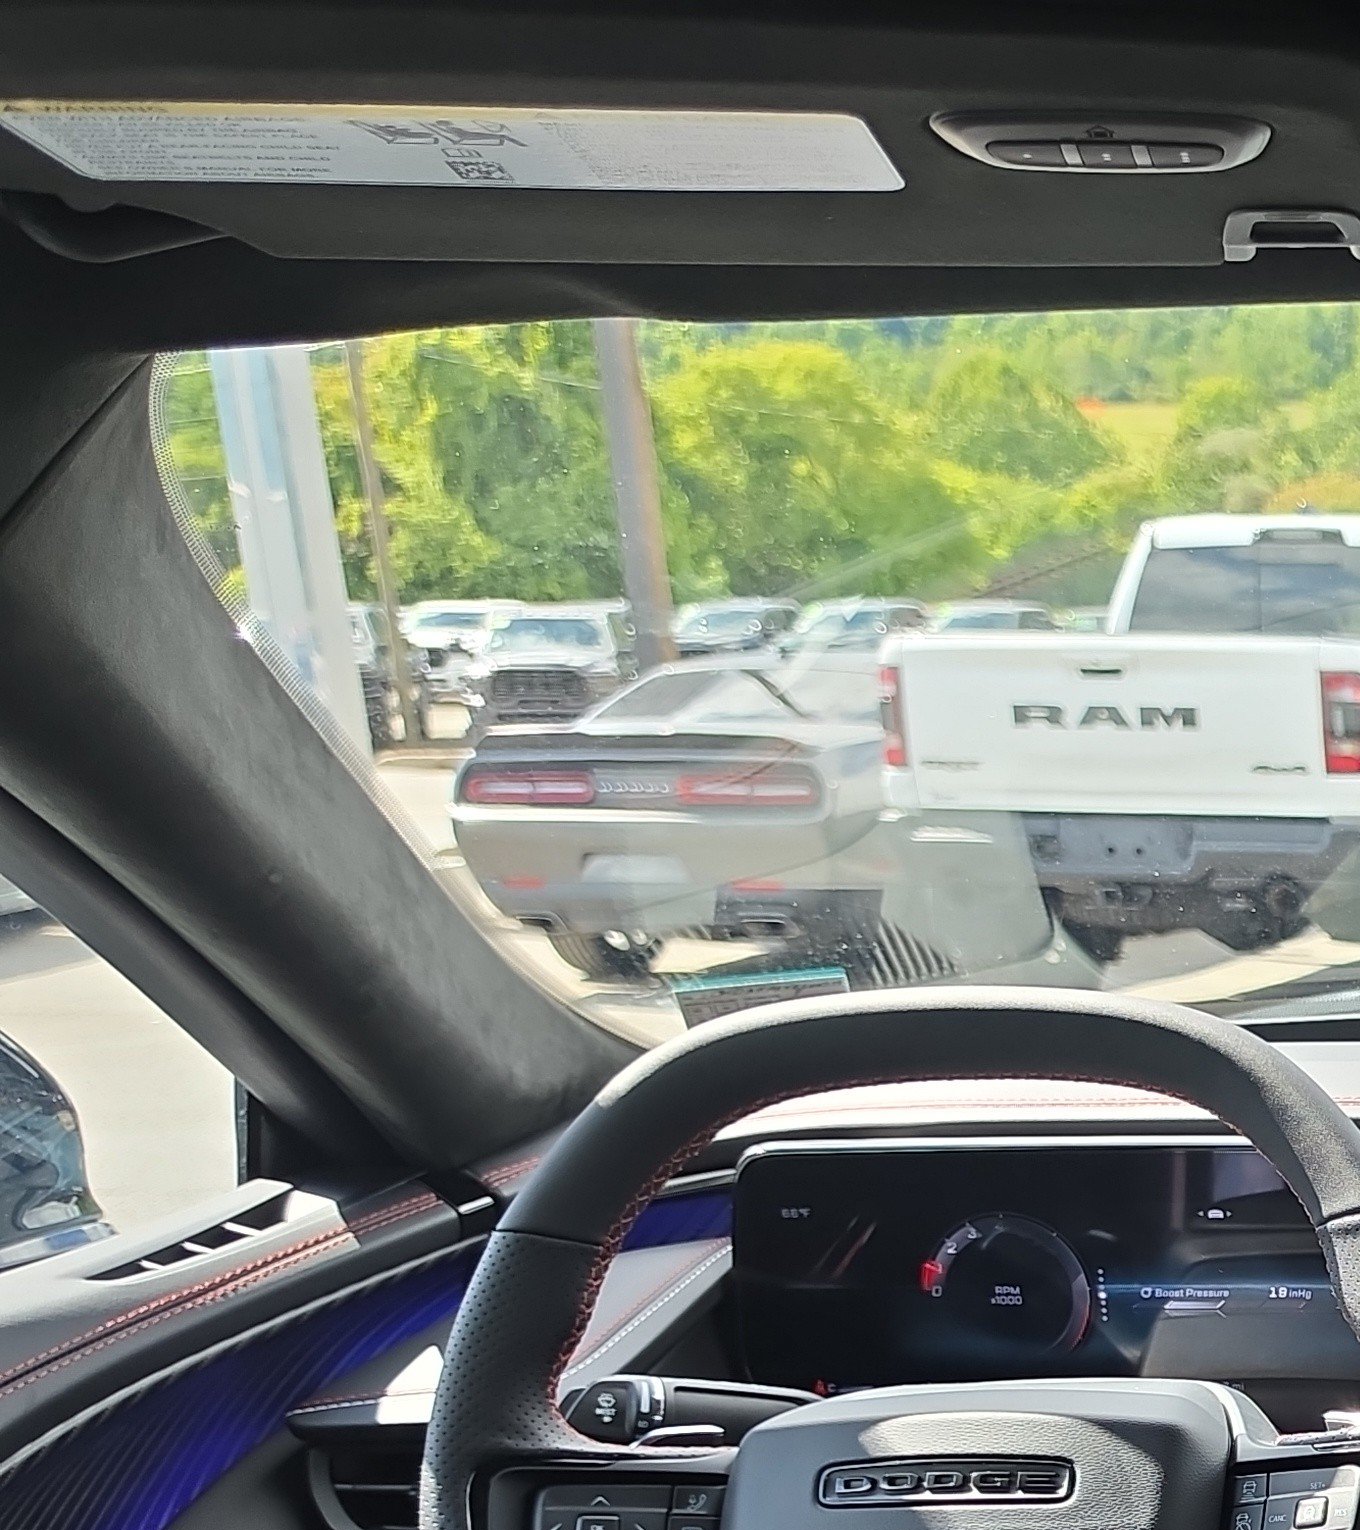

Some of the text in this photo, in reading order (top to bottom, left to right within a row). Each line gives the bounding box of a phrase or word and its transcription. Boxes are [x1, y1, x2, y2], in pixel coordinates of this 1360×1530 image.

[1010, 705, 1199, 728] RAM
[947, 1241, 958, 1254] 2
[931, 1285, 942, 1297] 0
[995, 1286, 1021, 1295] RPM
[1155, 1287, 1183, 1298] Boost
[1186, 1287, 1230, 1298] Pressure
[1289, 1288, 1312, 1300] inHg
[835, 1471, 1061, 1494] DODGE
[1268, 1514, 1287, 1523] CANC
